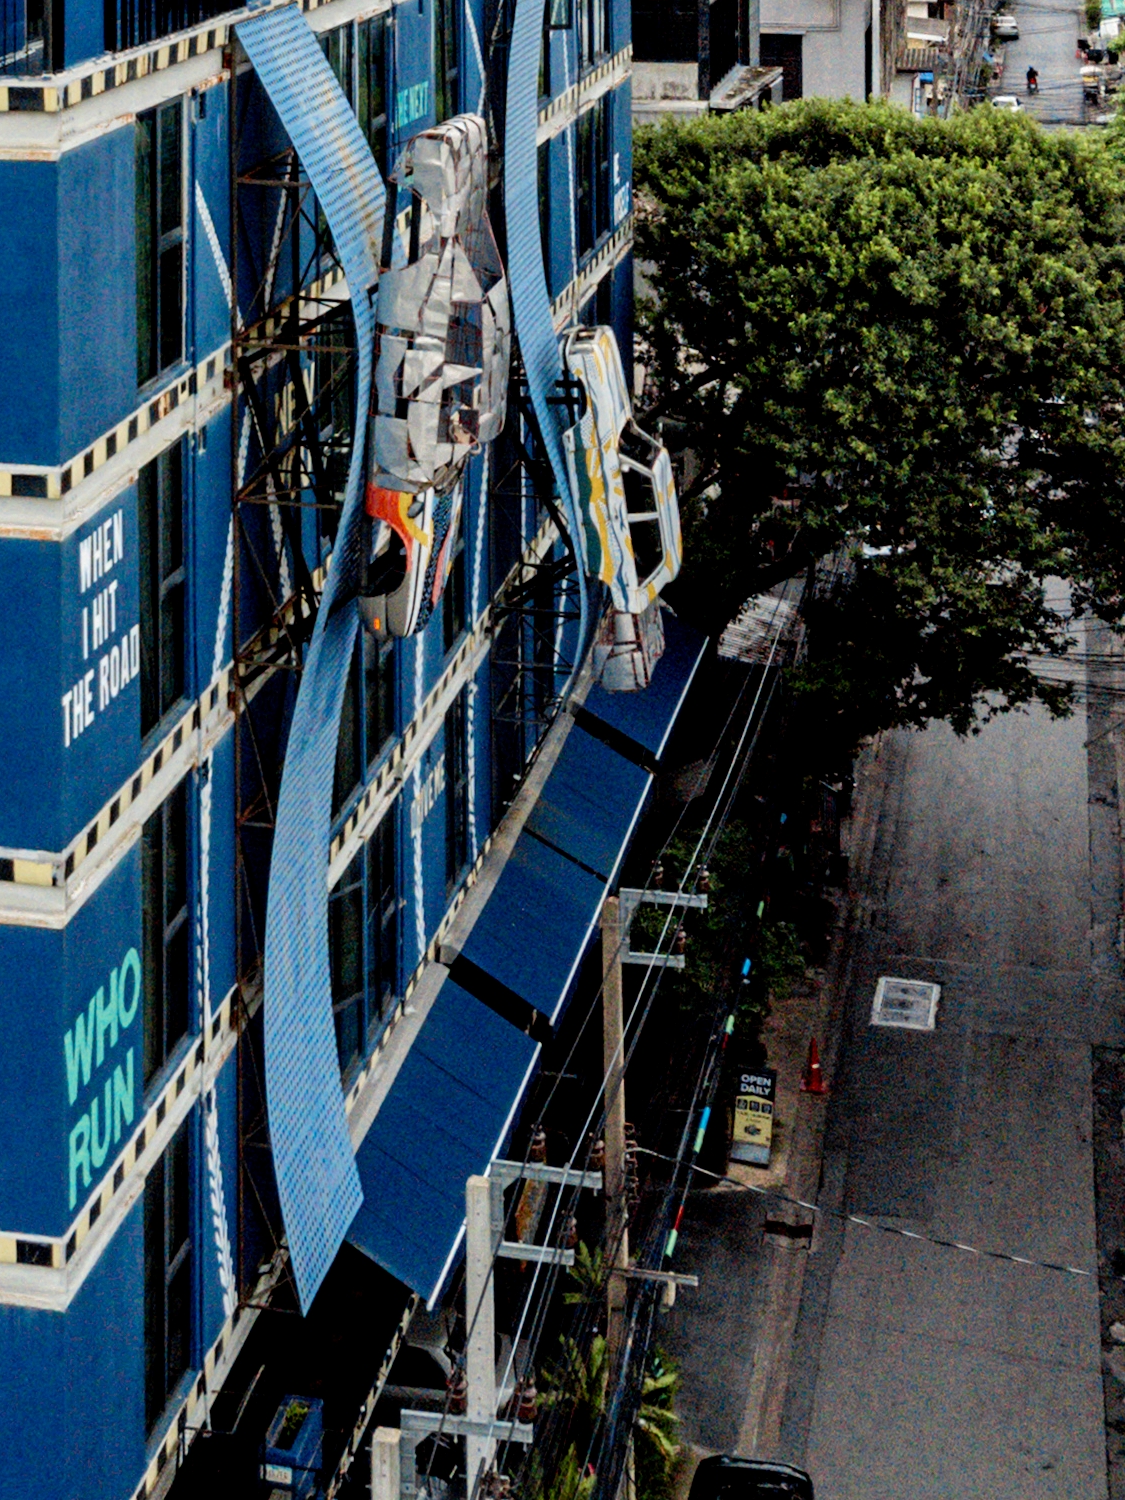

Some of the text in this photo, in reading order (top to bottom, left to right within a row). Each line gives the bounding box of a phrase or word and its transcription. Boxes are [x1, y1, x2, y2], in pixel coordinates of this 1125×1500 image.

[79, 509, 123, 593] WHEN
[82, 579, 118, 660] I HIT
[61, 623, 140, 748] THE ROAD
[64, 946, 141, 1107] WHO
[740, 1083, 771, 1096] DAILY
[741, 1074, 772, 1087] OPEN
[69, 1046, 134, 1211] RUN
